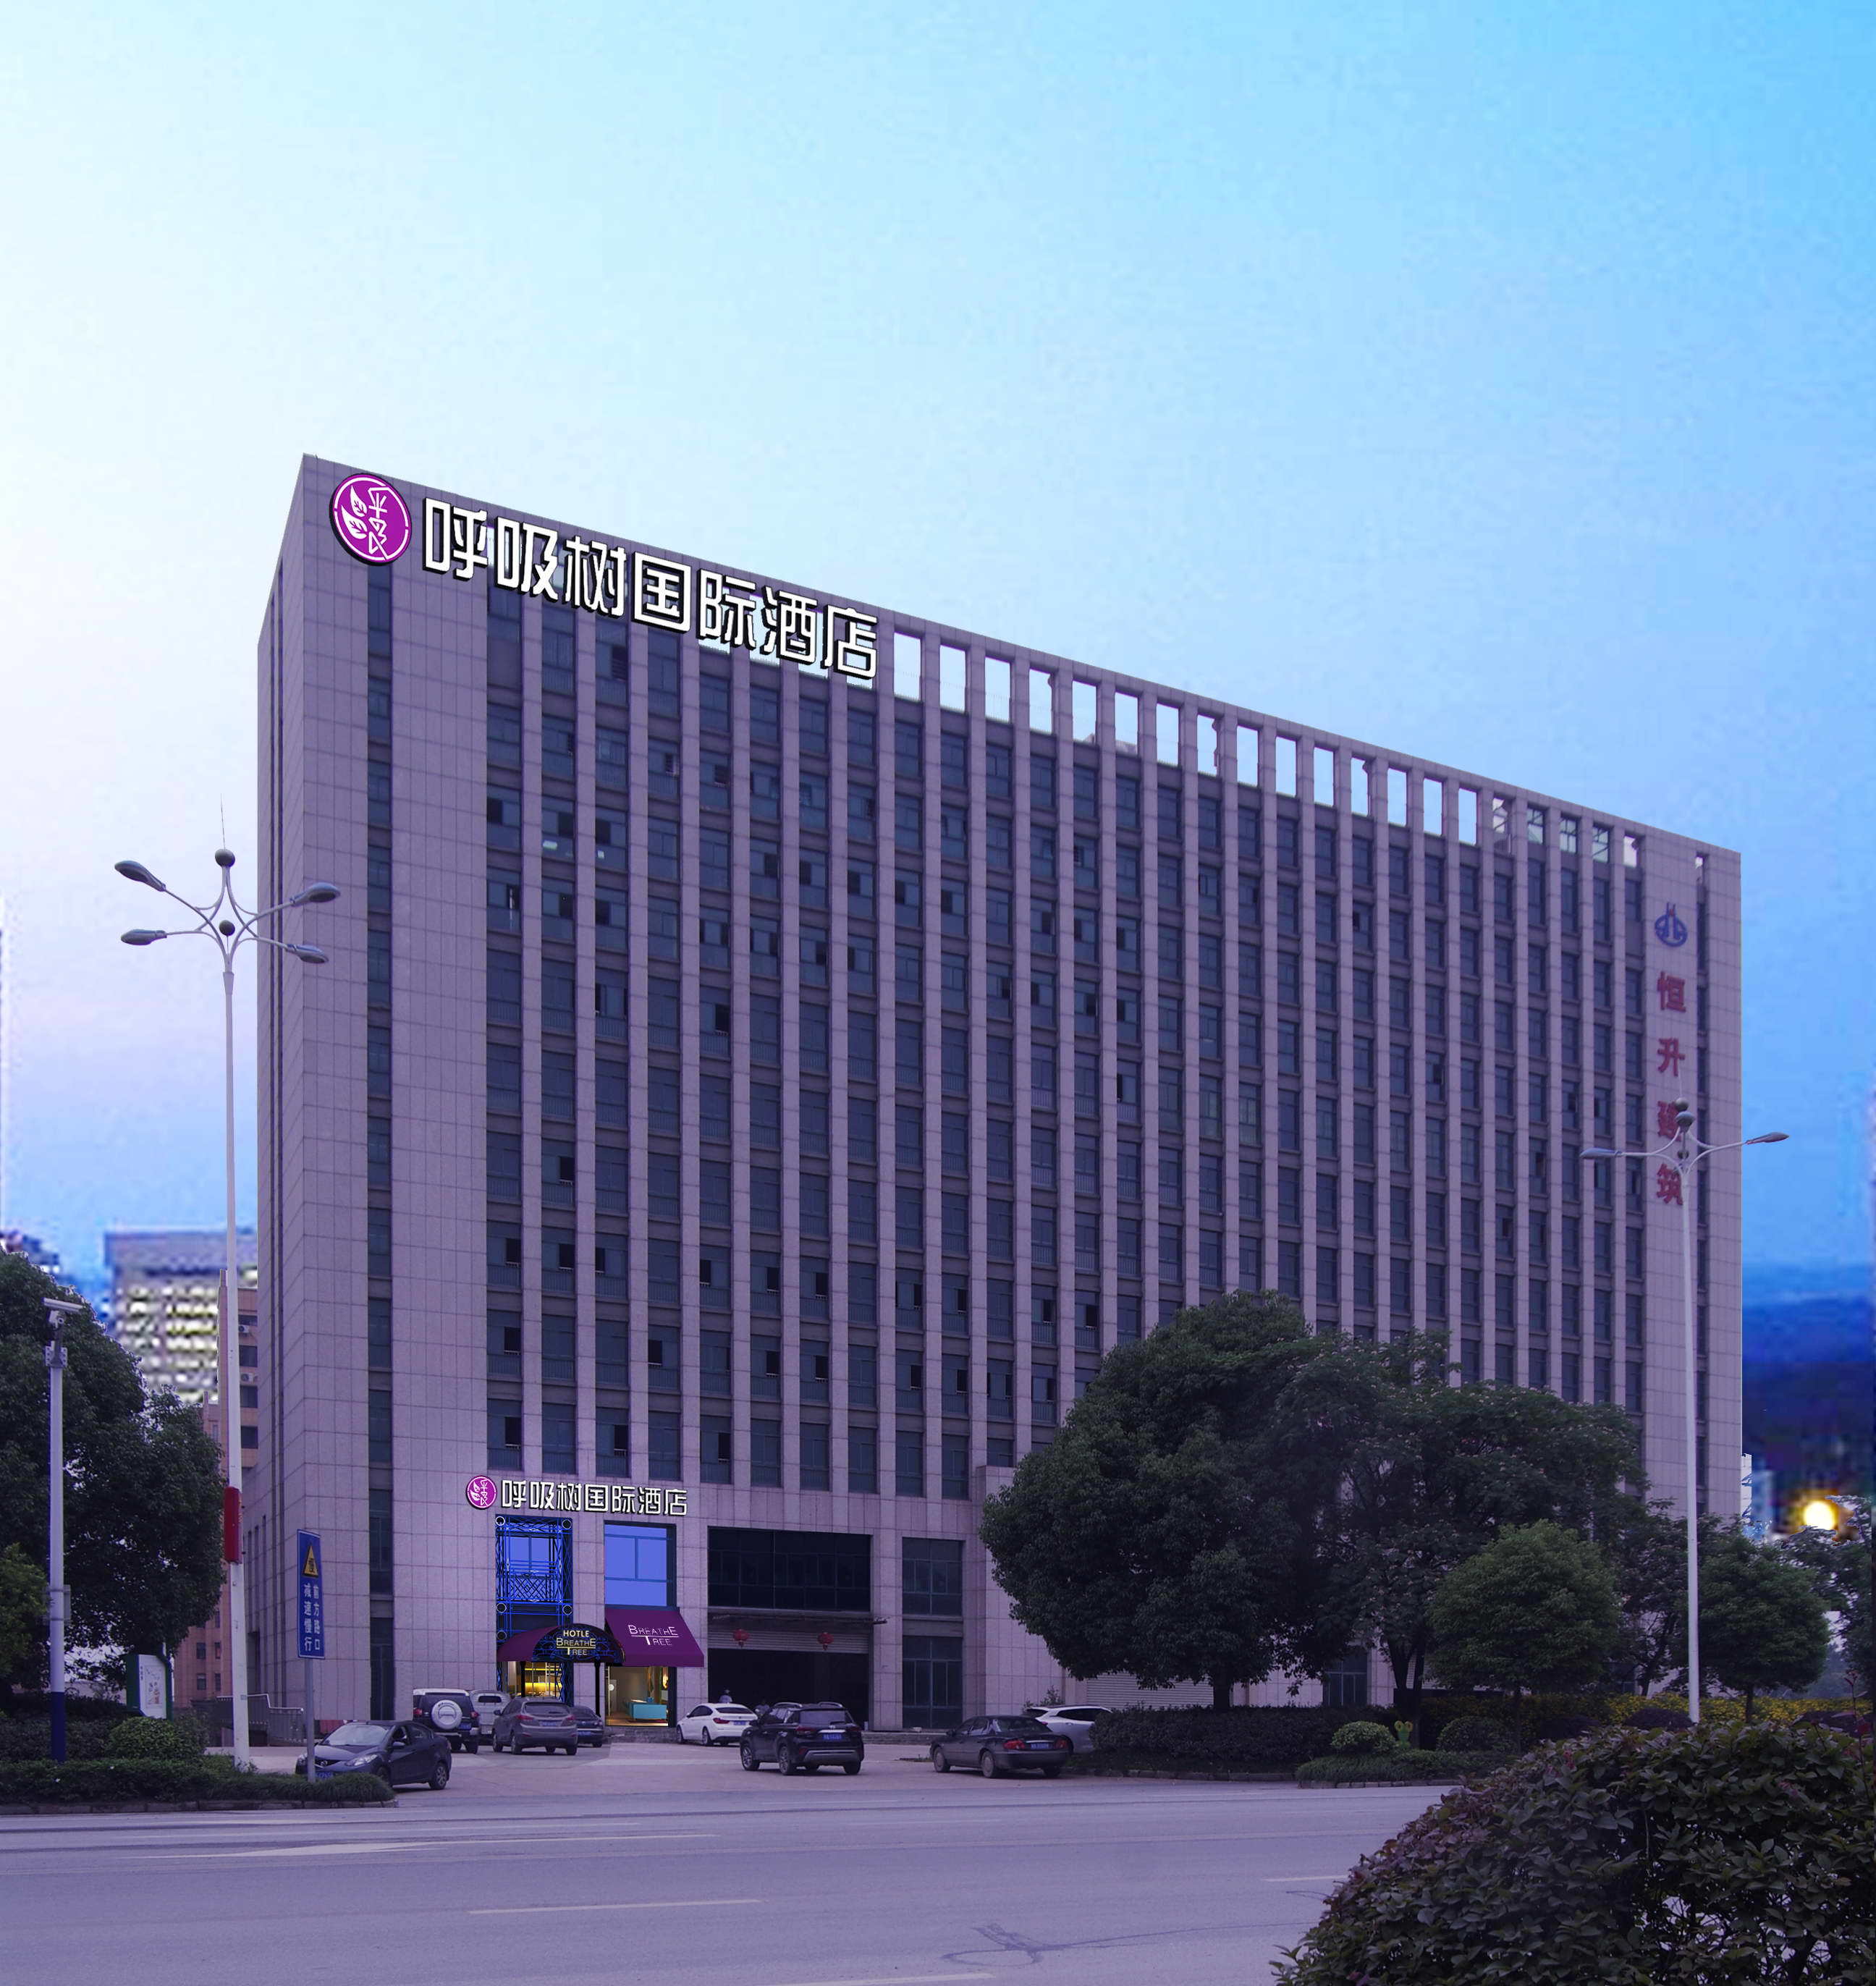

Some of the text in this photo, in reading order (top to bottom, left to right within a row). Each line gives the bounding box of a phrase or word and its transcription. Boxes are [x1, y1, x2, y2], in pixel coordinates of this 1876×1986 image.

[423, 497, 878, 679] 呼吸树国际酒店
[501, 1479, 688, 1516] 呼吸树国际酒店
